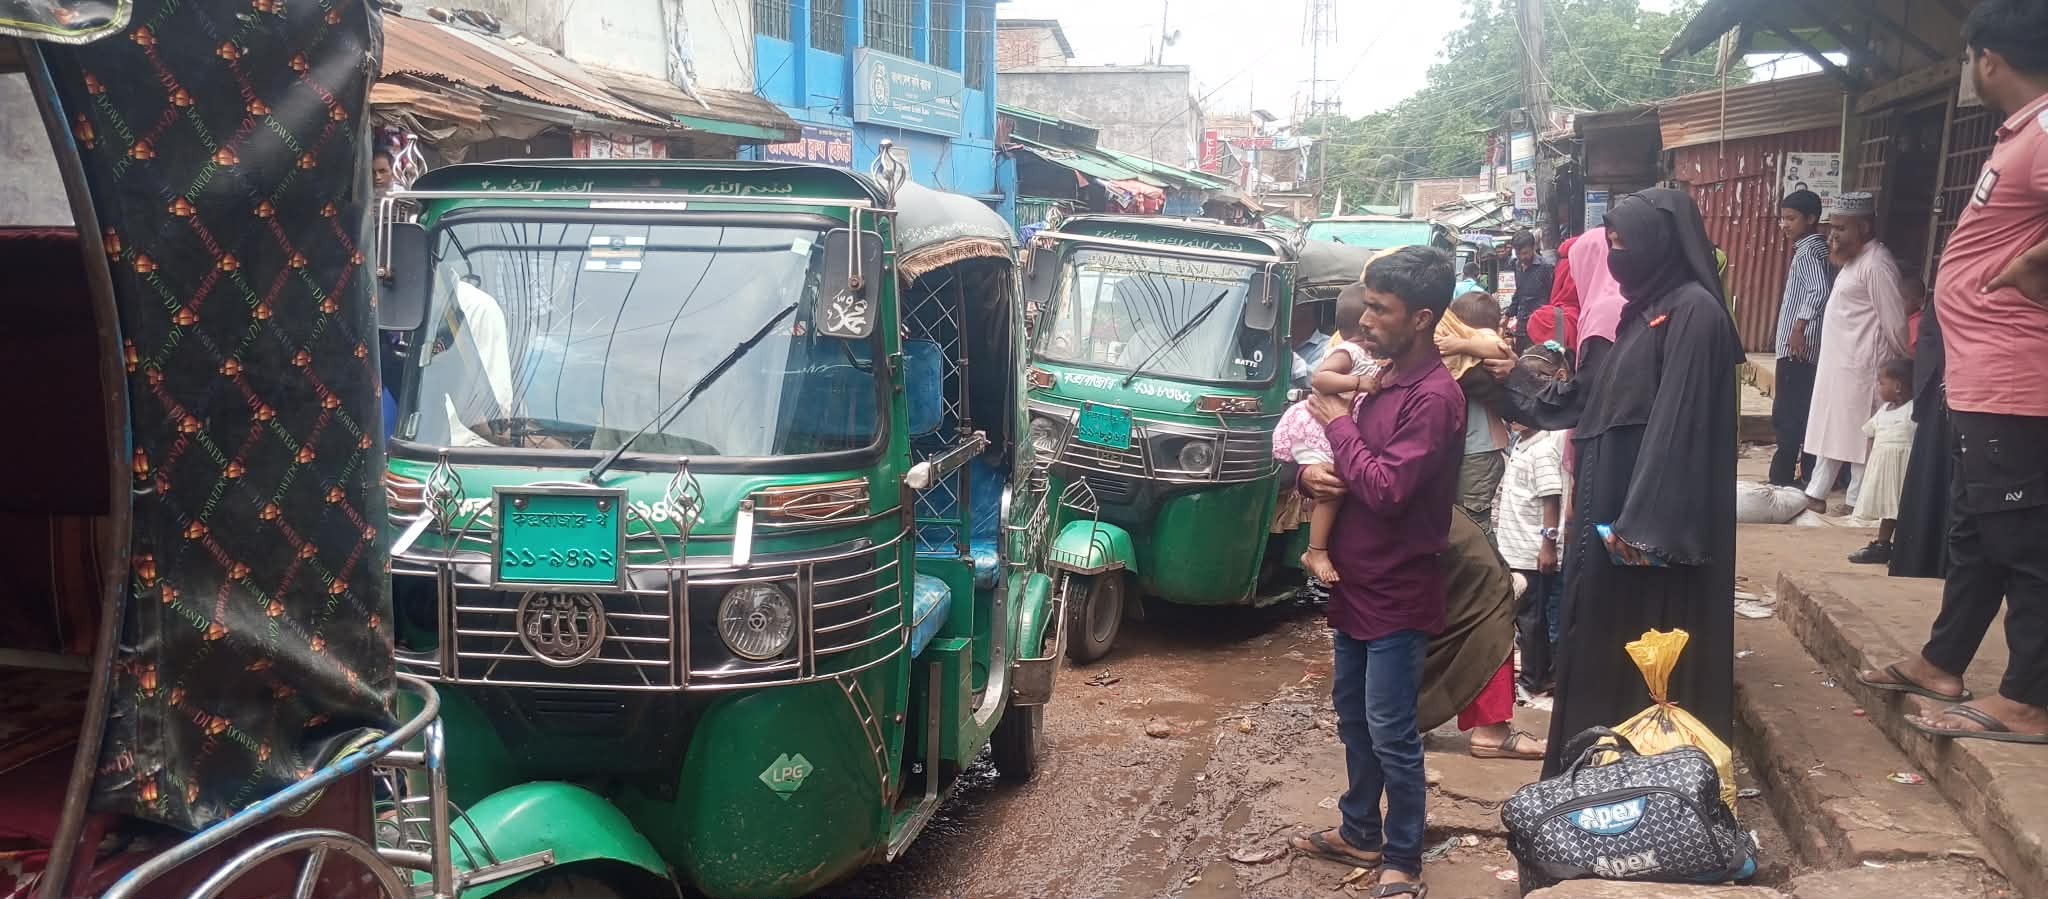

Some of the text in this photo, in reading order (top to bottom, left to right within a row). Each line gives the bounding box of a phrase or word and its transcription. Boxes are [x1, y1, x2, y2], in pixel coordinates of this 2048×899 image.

[98, 94, 136, 146] DOWEDO
[186, 106, 218, 153] DOWEDO
[185, 160, 217, 204] DOWEDO
[171, 598, 210, 632] YUANDI
[773, 764, 803, 783] LPG
[1578, 799, 1643, 830] Apex
[1592, 848, 1660, 879] Apex
